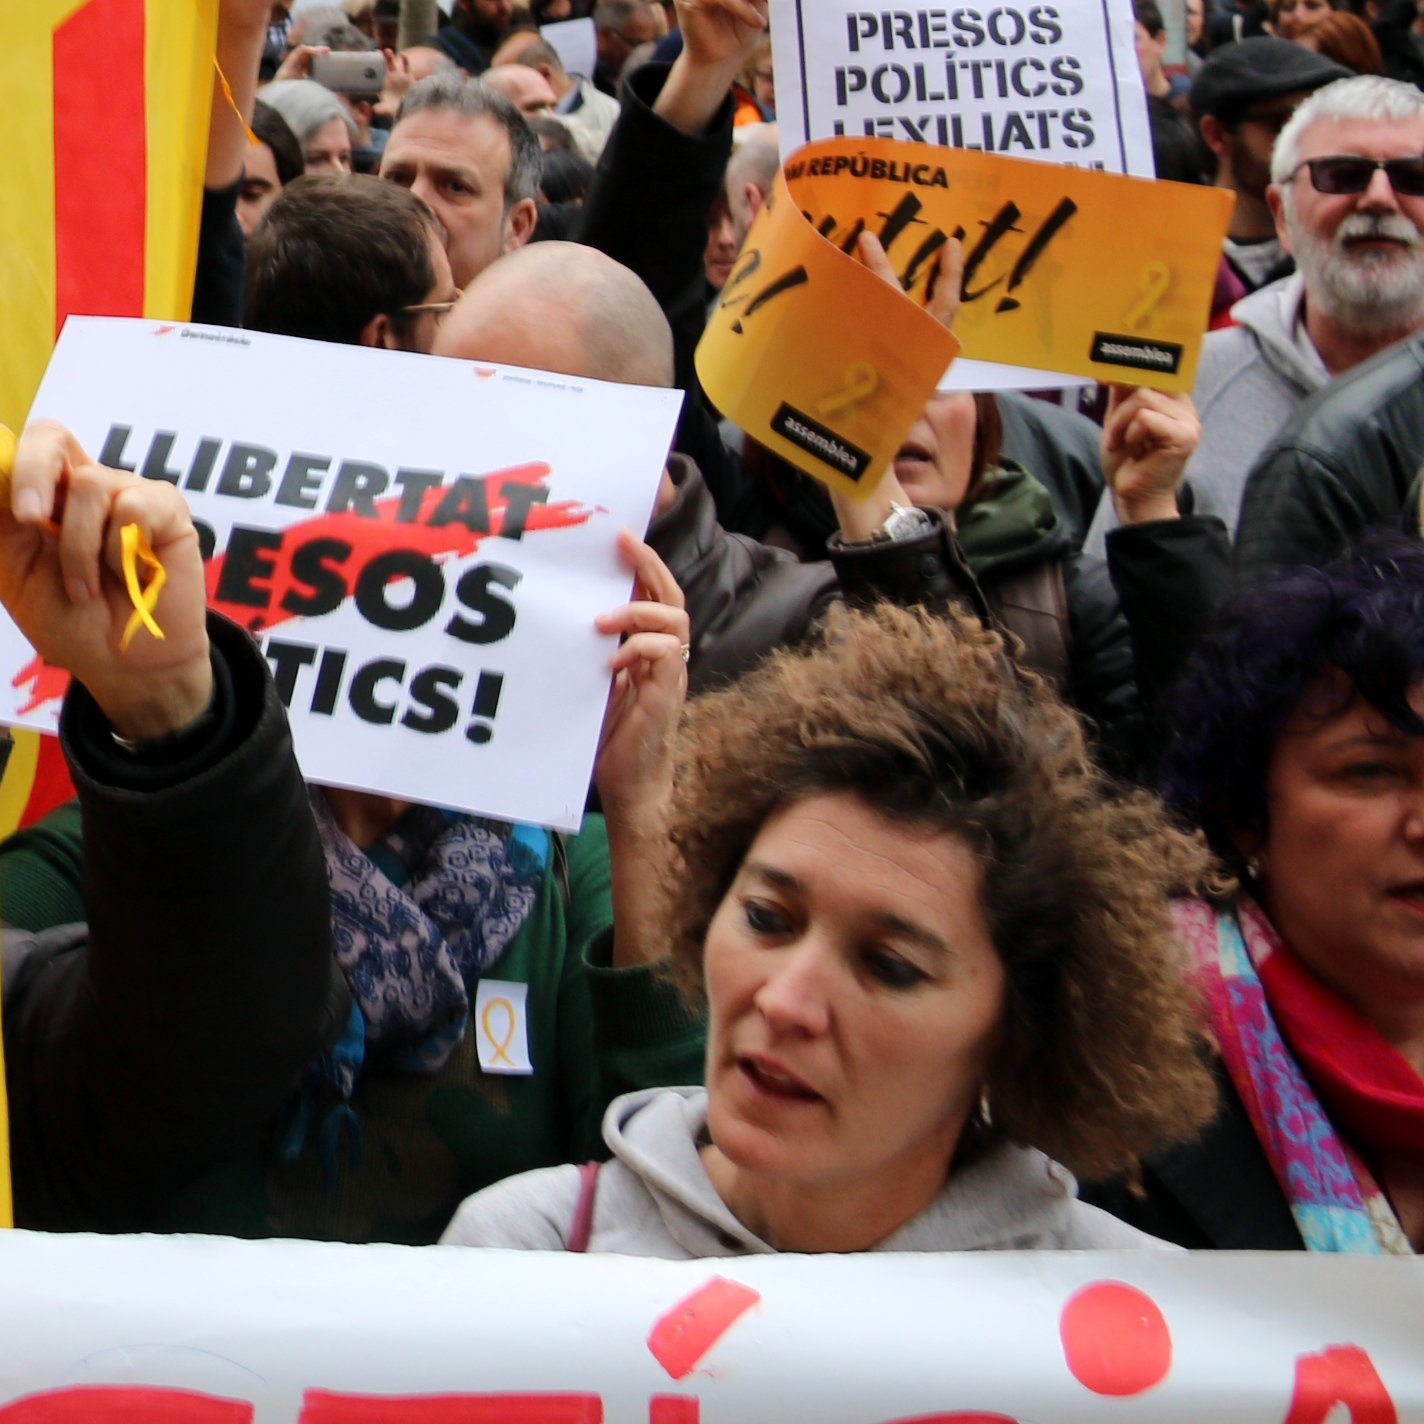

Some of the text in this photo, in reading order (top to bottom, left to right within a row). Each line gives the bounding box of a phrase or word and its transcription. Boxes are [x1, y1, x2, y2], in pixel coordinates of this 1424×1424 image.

[846, 5, 1064, 52] PRESOS
[833, 50, 1084, 106] POLÍTICS
[808, 151, 950, 189] REPÚBLICA
[1098, 339, 1174, 369] assemblea
[783, 413, 860, 473] assemblea
[97, 421, 551, 542] LLIBERTAT
[190, 516, 525, 646] ESOS
[261, 638, 506, 746] TICS!
